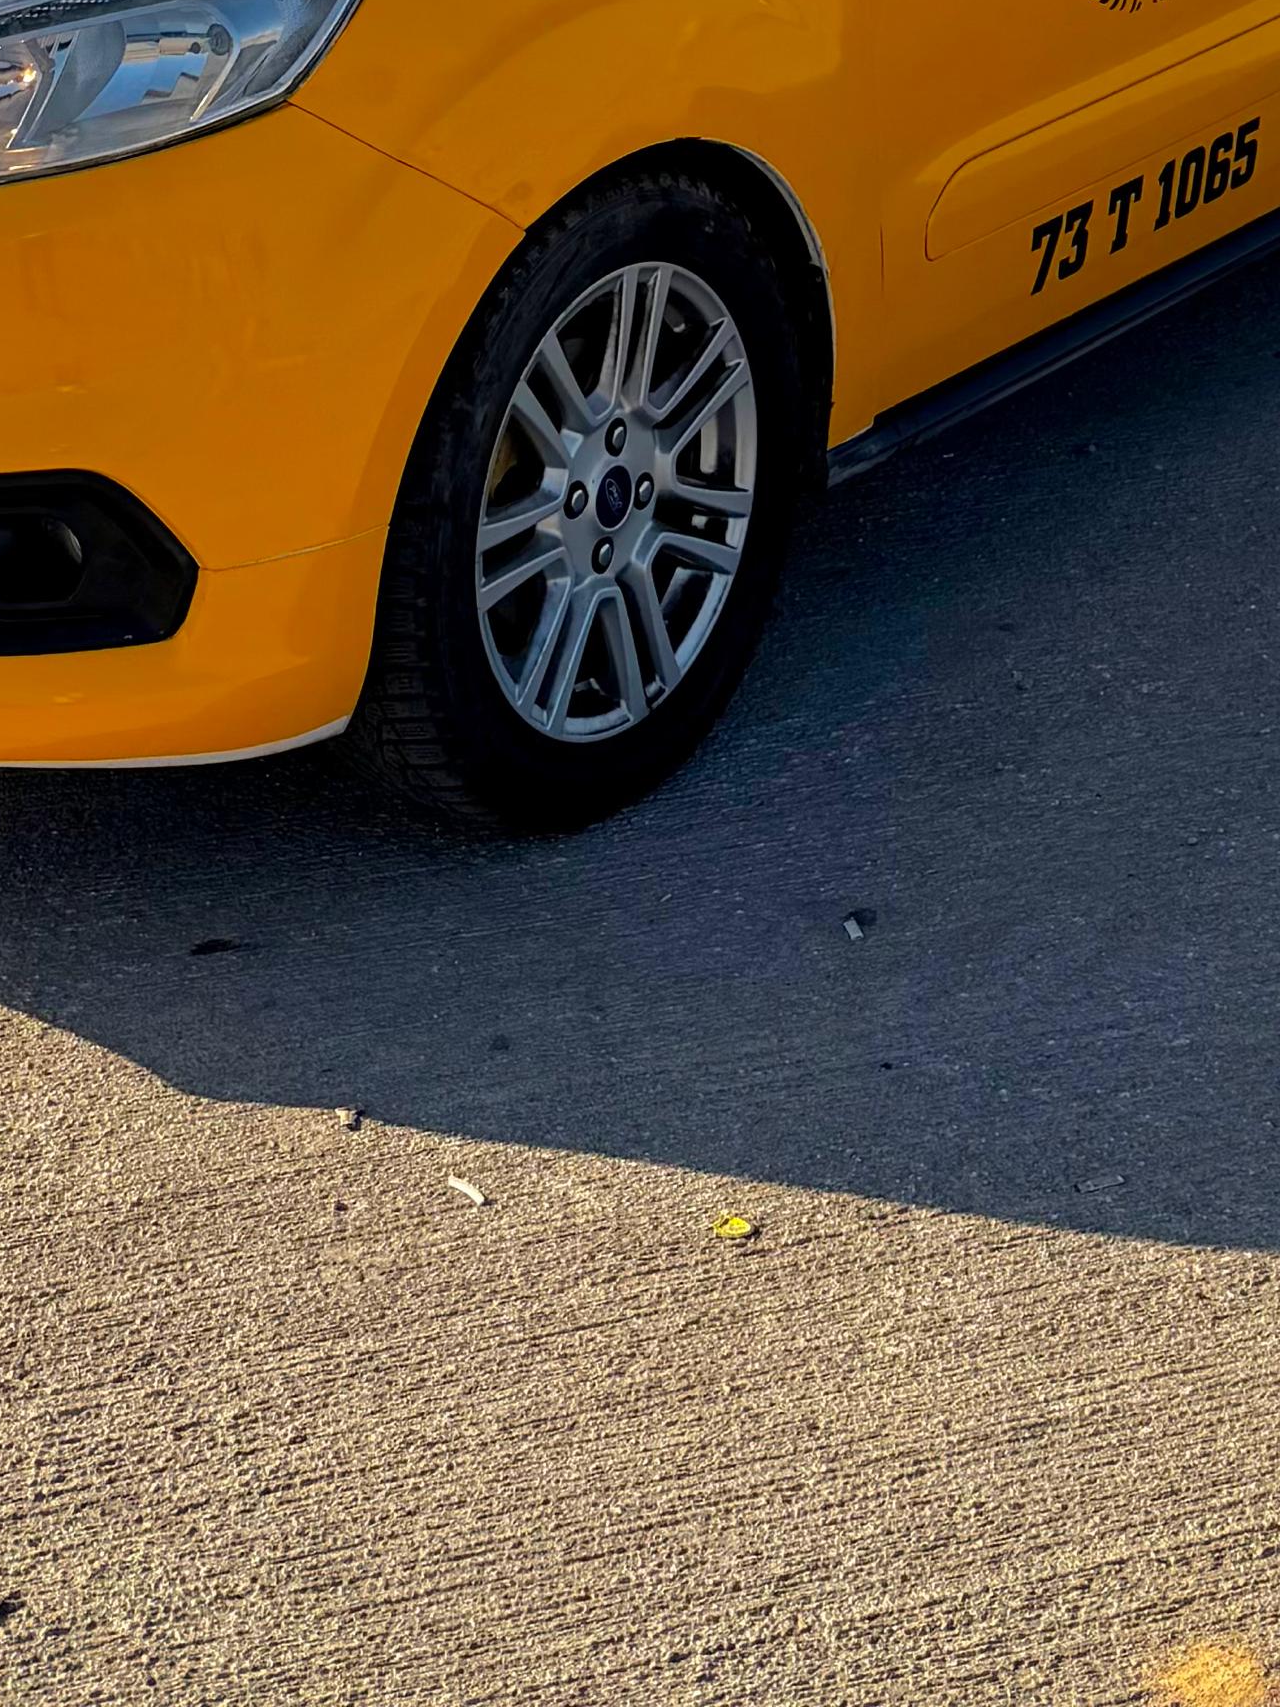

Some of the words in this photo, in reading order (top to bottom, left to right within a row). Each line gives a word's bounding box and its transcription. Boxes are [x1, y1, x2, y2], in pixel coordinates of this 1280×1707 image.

[1030, 199, 1095, 296] 73
[1107, 175, 1144, 256] T
[1153, 116, 1261, 233] 1065
